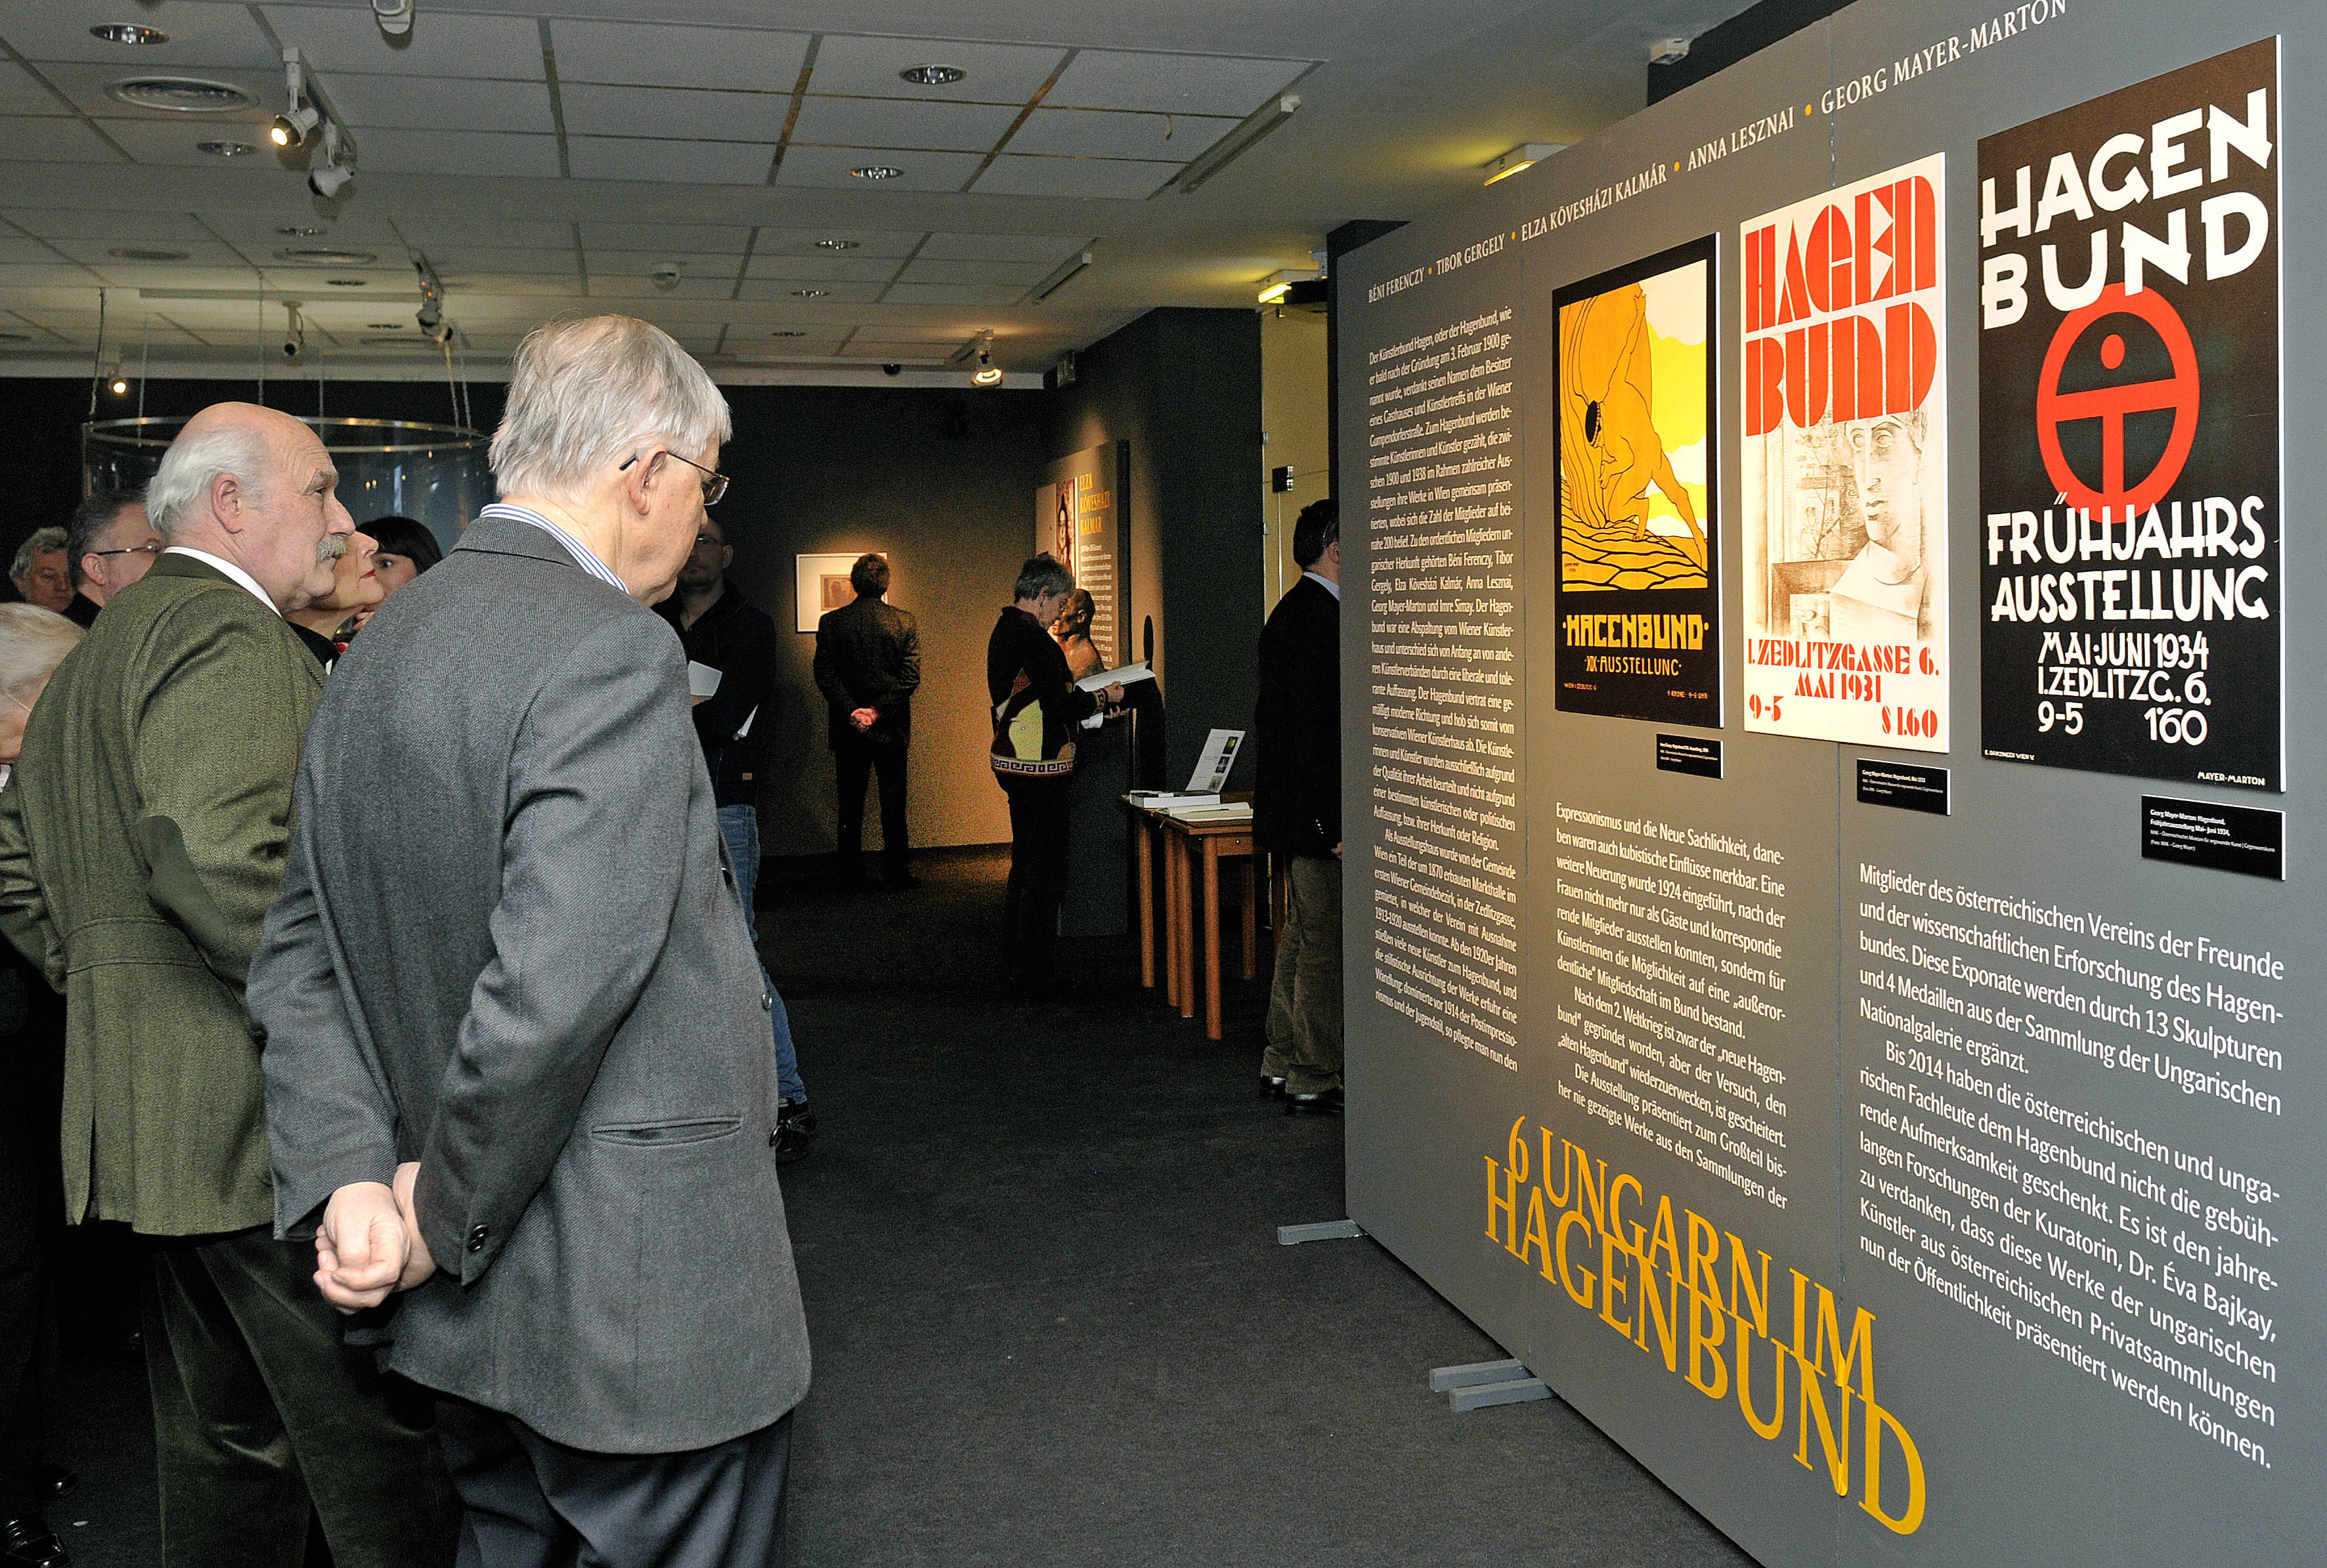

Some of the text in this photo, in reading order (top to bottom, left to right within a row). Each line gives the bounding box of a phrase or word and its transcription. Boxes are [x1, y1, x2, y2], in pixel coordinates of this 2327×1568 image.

[1368, 0, 2066, 303] BÉNI FERENCZY TIBOR GERGELY ELZA KÖVESHÁZI KALMÁR ANNA LESZNAI GEORG MAYER-MARTON
[1980, 87, 2273, 248] HAGEN
[1746, 176, 1936, 333] HAGEN
[1982, 191, 2269, 330] BUND
[1746, 302, 1937, 436] BUND
[1987, 492, 2265, 565] FRÜHJAHRS
[1991, 565, 2270, 622] AUSSTELLUNG
[2153, 630, 2209, 670] 1934
[1794, 672, 1881, 703] MAI 1931
[1919, 647, 1940, 676] 6.
[2038, 701, 2083, 735] 9-5
[2185, 671, 2211, 706] 6.
[1556, 802, 1785, 865] Expressionismus und die Neue Sachlichkeit, dane-
[2197, 771, 2265, 786] MAYER-MARTON
[1557, 878, 1782, 959] Frauen nicht mehr nur als Gäste und korrespondie
[1860, 863, 2284, 980] Mitglieder des österreichischen Vereins der Freunde
[1860, 902, 2283, 1024] und der wissenschaftlichen Erforschung des Hagen-
[1597, 969, 1658, 1006] Mitgliedschaft
[1659, 991, 1672, 1011] im
[1674, 996, 1699, 1022] Bund
[1702, 1006, 1746, 1039] bestand.
[1860, 930, 2282, 1070] bundes. Diese Exponate werden durch 13 Skulpturen
[1558, 1079, 1788, 1209] her nie gezeigte Werke aus den Sammlungen der
[1630, 1064, 1714, 1118] wiederzuerwecken,
[1716, 1100, 1727, 1121] ist
[1728, 1110, 1787, 1148] gescheitert.
[1886, 1040, 2280, 1204] Bis 2014 haben die österreichischen und unga-
[1509, 1116, 1877, 1402] 6 UNGARN IM
[1861, 1197, 2274, 1426] Künstler aus österreichischen Privatsammlungen
[1484, 1155, 1926, 1535] HAGENBUND
[1861, 1235, 2271, 1469] nun der Öffentlichkeit präsentiert werden können.
